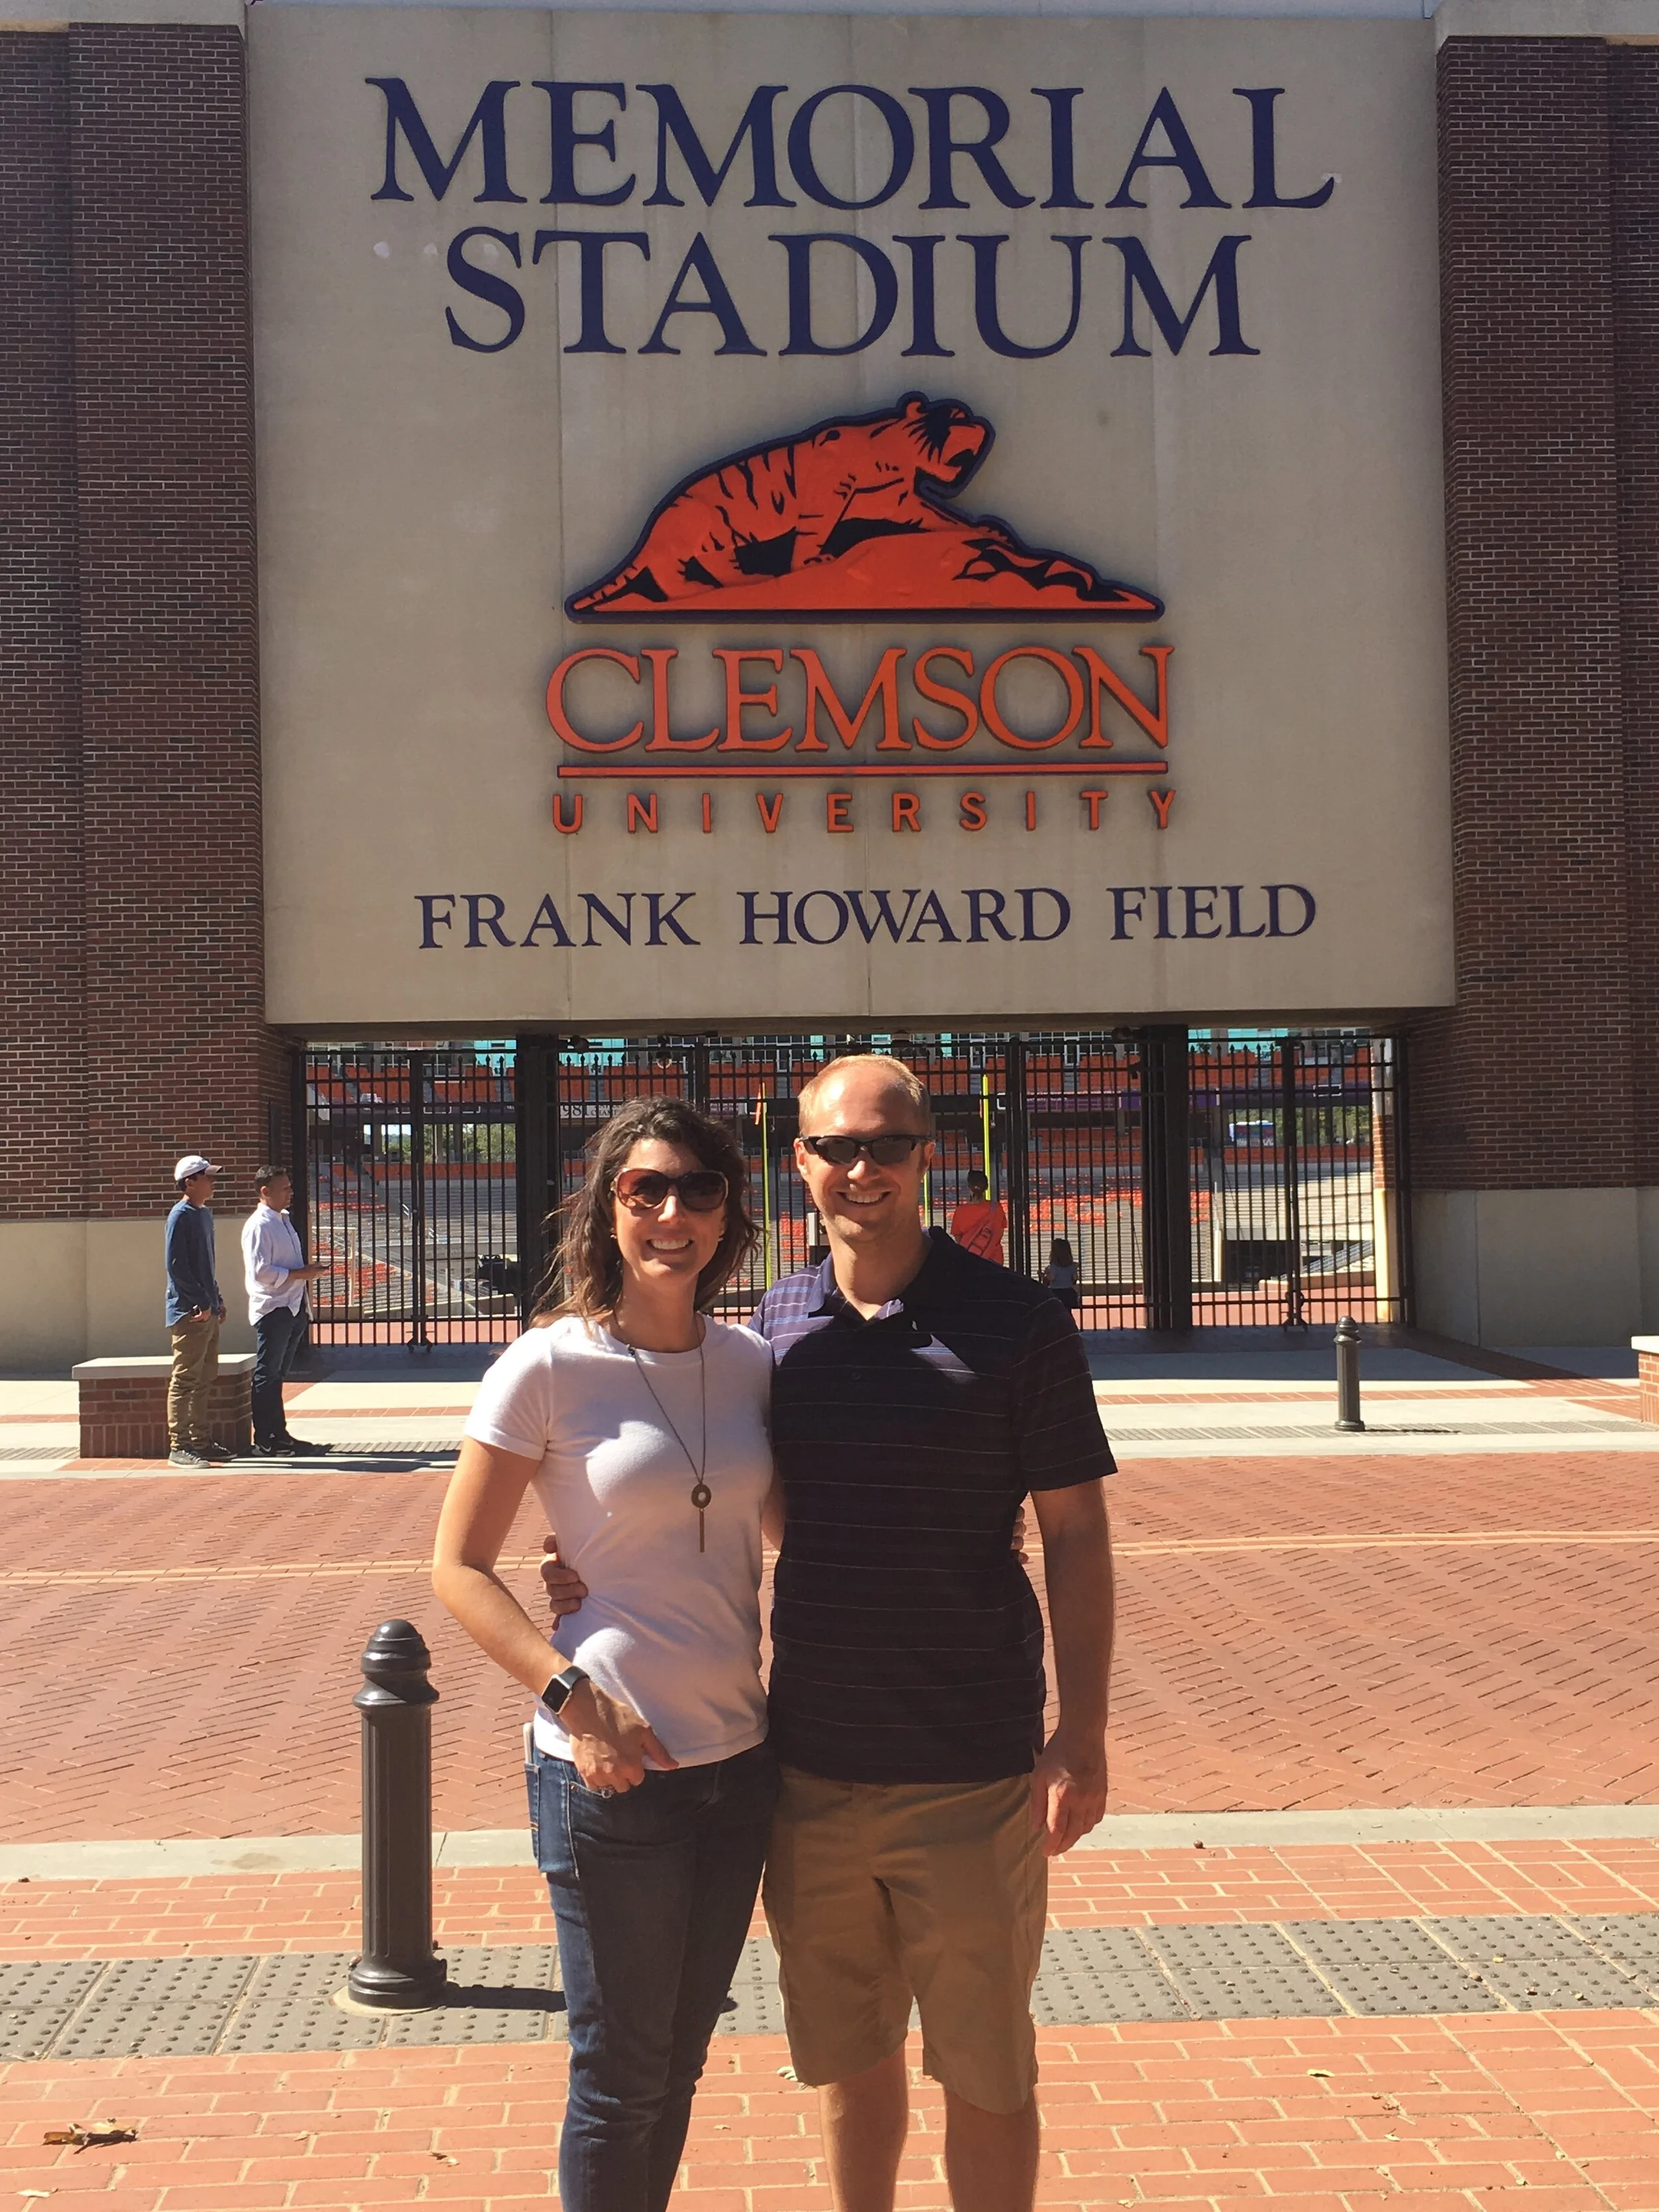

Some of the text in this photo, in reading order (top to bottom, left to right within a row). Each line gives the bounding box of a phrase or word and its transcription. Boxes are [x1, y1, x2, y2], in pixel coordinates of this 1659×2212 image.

[365, 77, 1334, 210] MEMORIAL
[445, 226, 1260, 358] STADIUM
[545, 646, 1174, 752] CLEMSON
[552, 790, 1175, 834] UNIVERSITY
[415, 885, 1315, 949] FRANK HOWARD FIELD
